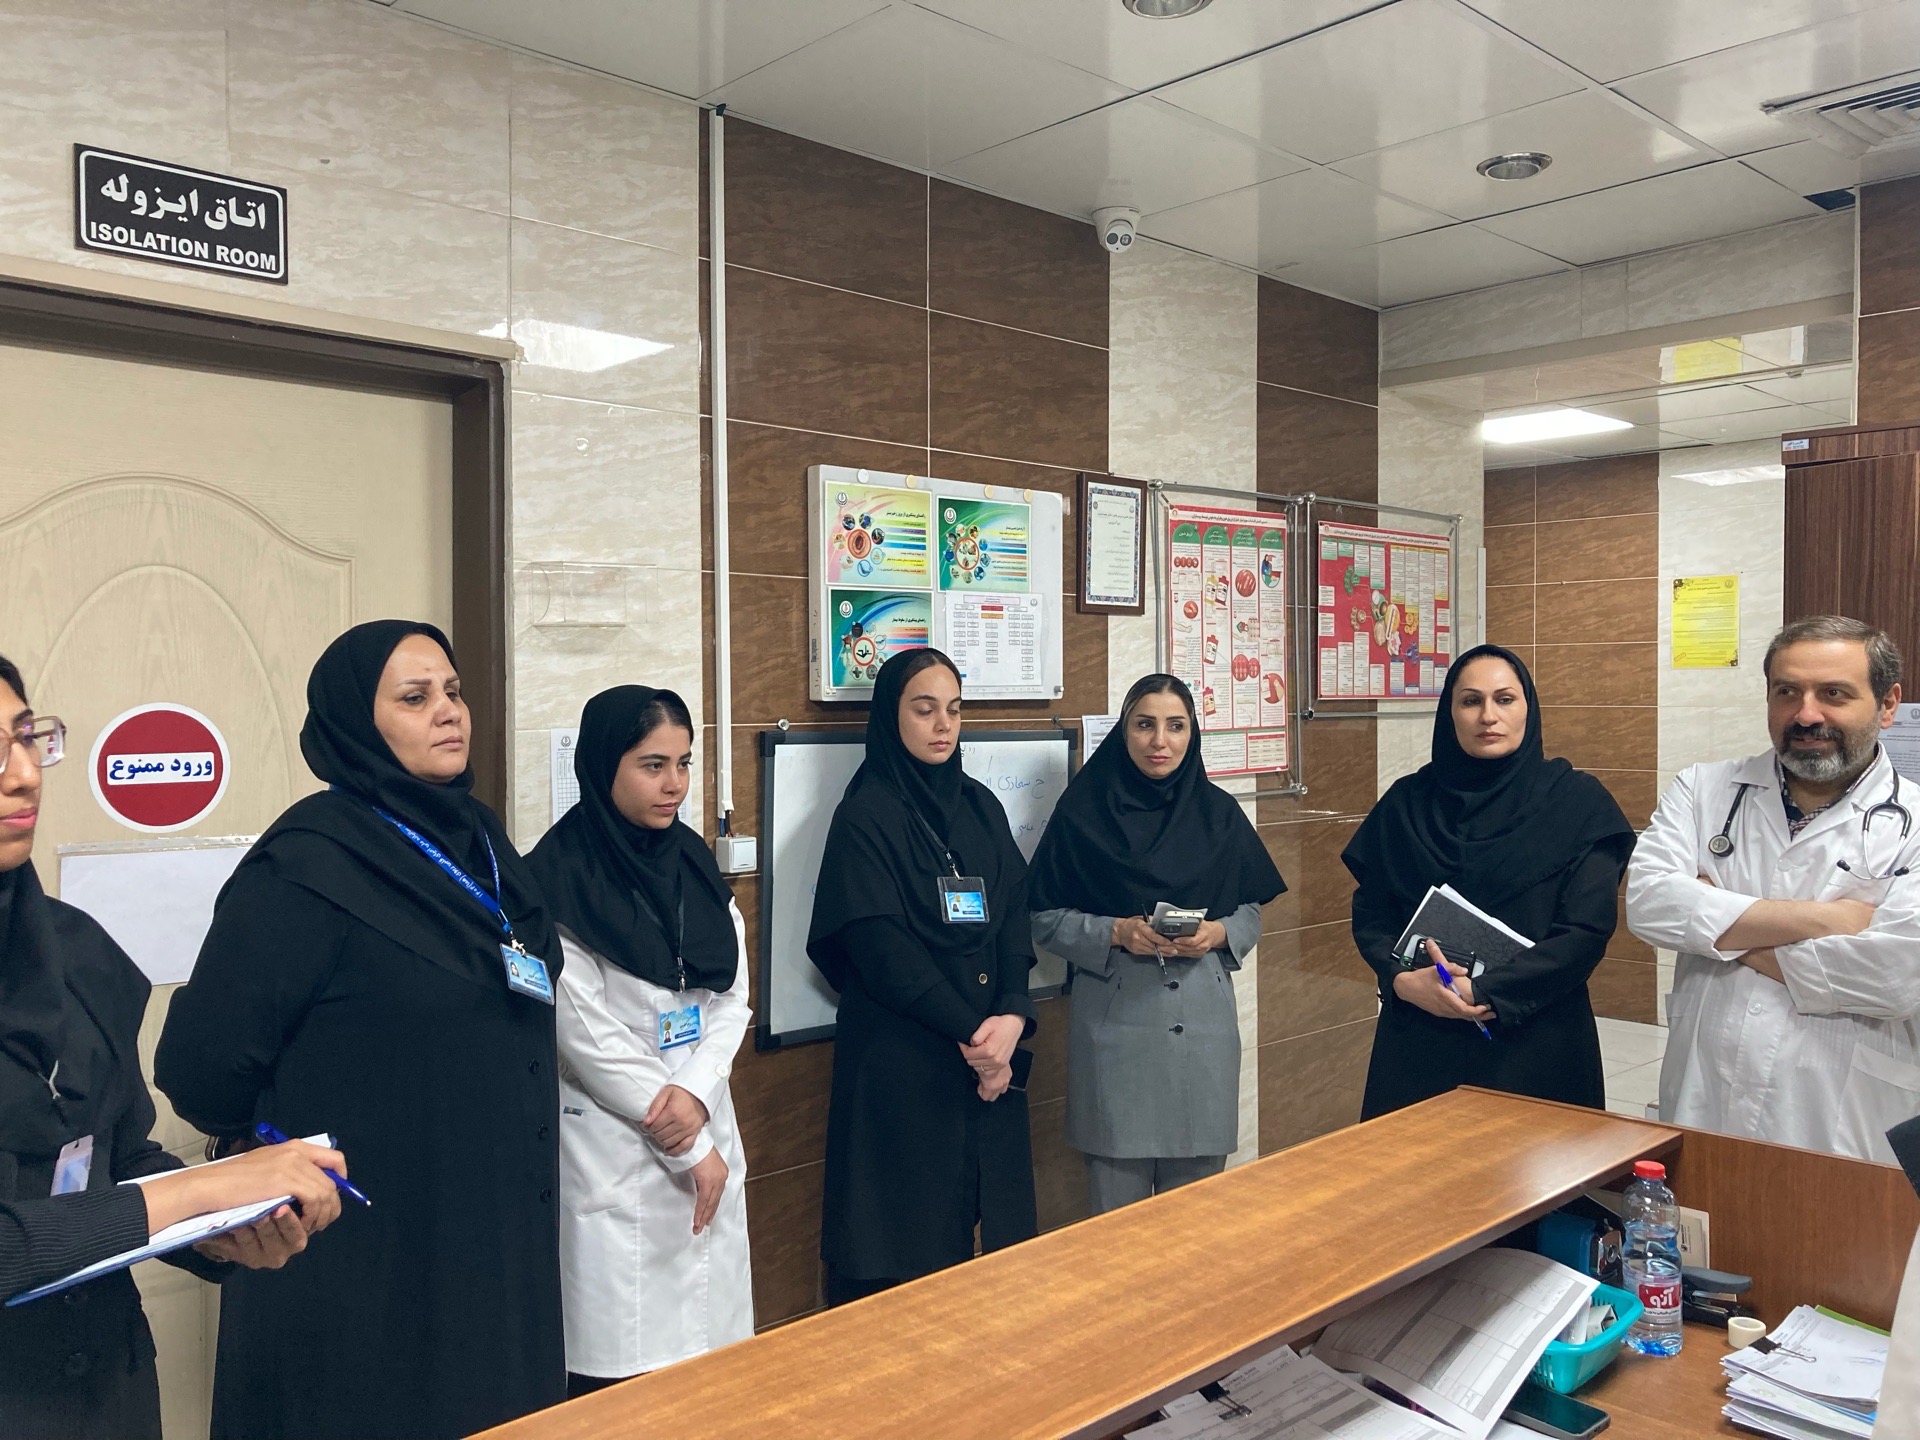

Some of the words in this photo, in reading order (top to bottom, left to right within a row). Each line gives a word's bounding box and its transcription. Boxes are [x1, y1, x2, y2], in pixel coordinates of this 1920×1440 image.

[100, 173, 199, 223] ایزوله
[204, 196, 266, 230] اتاق
[90, 221, 209, 259] ISOLATION
[216, 245, 276, 271] ROOM
[109, 758, 165, 780] ممنوع
[170, 758, 213, 777] ورود
